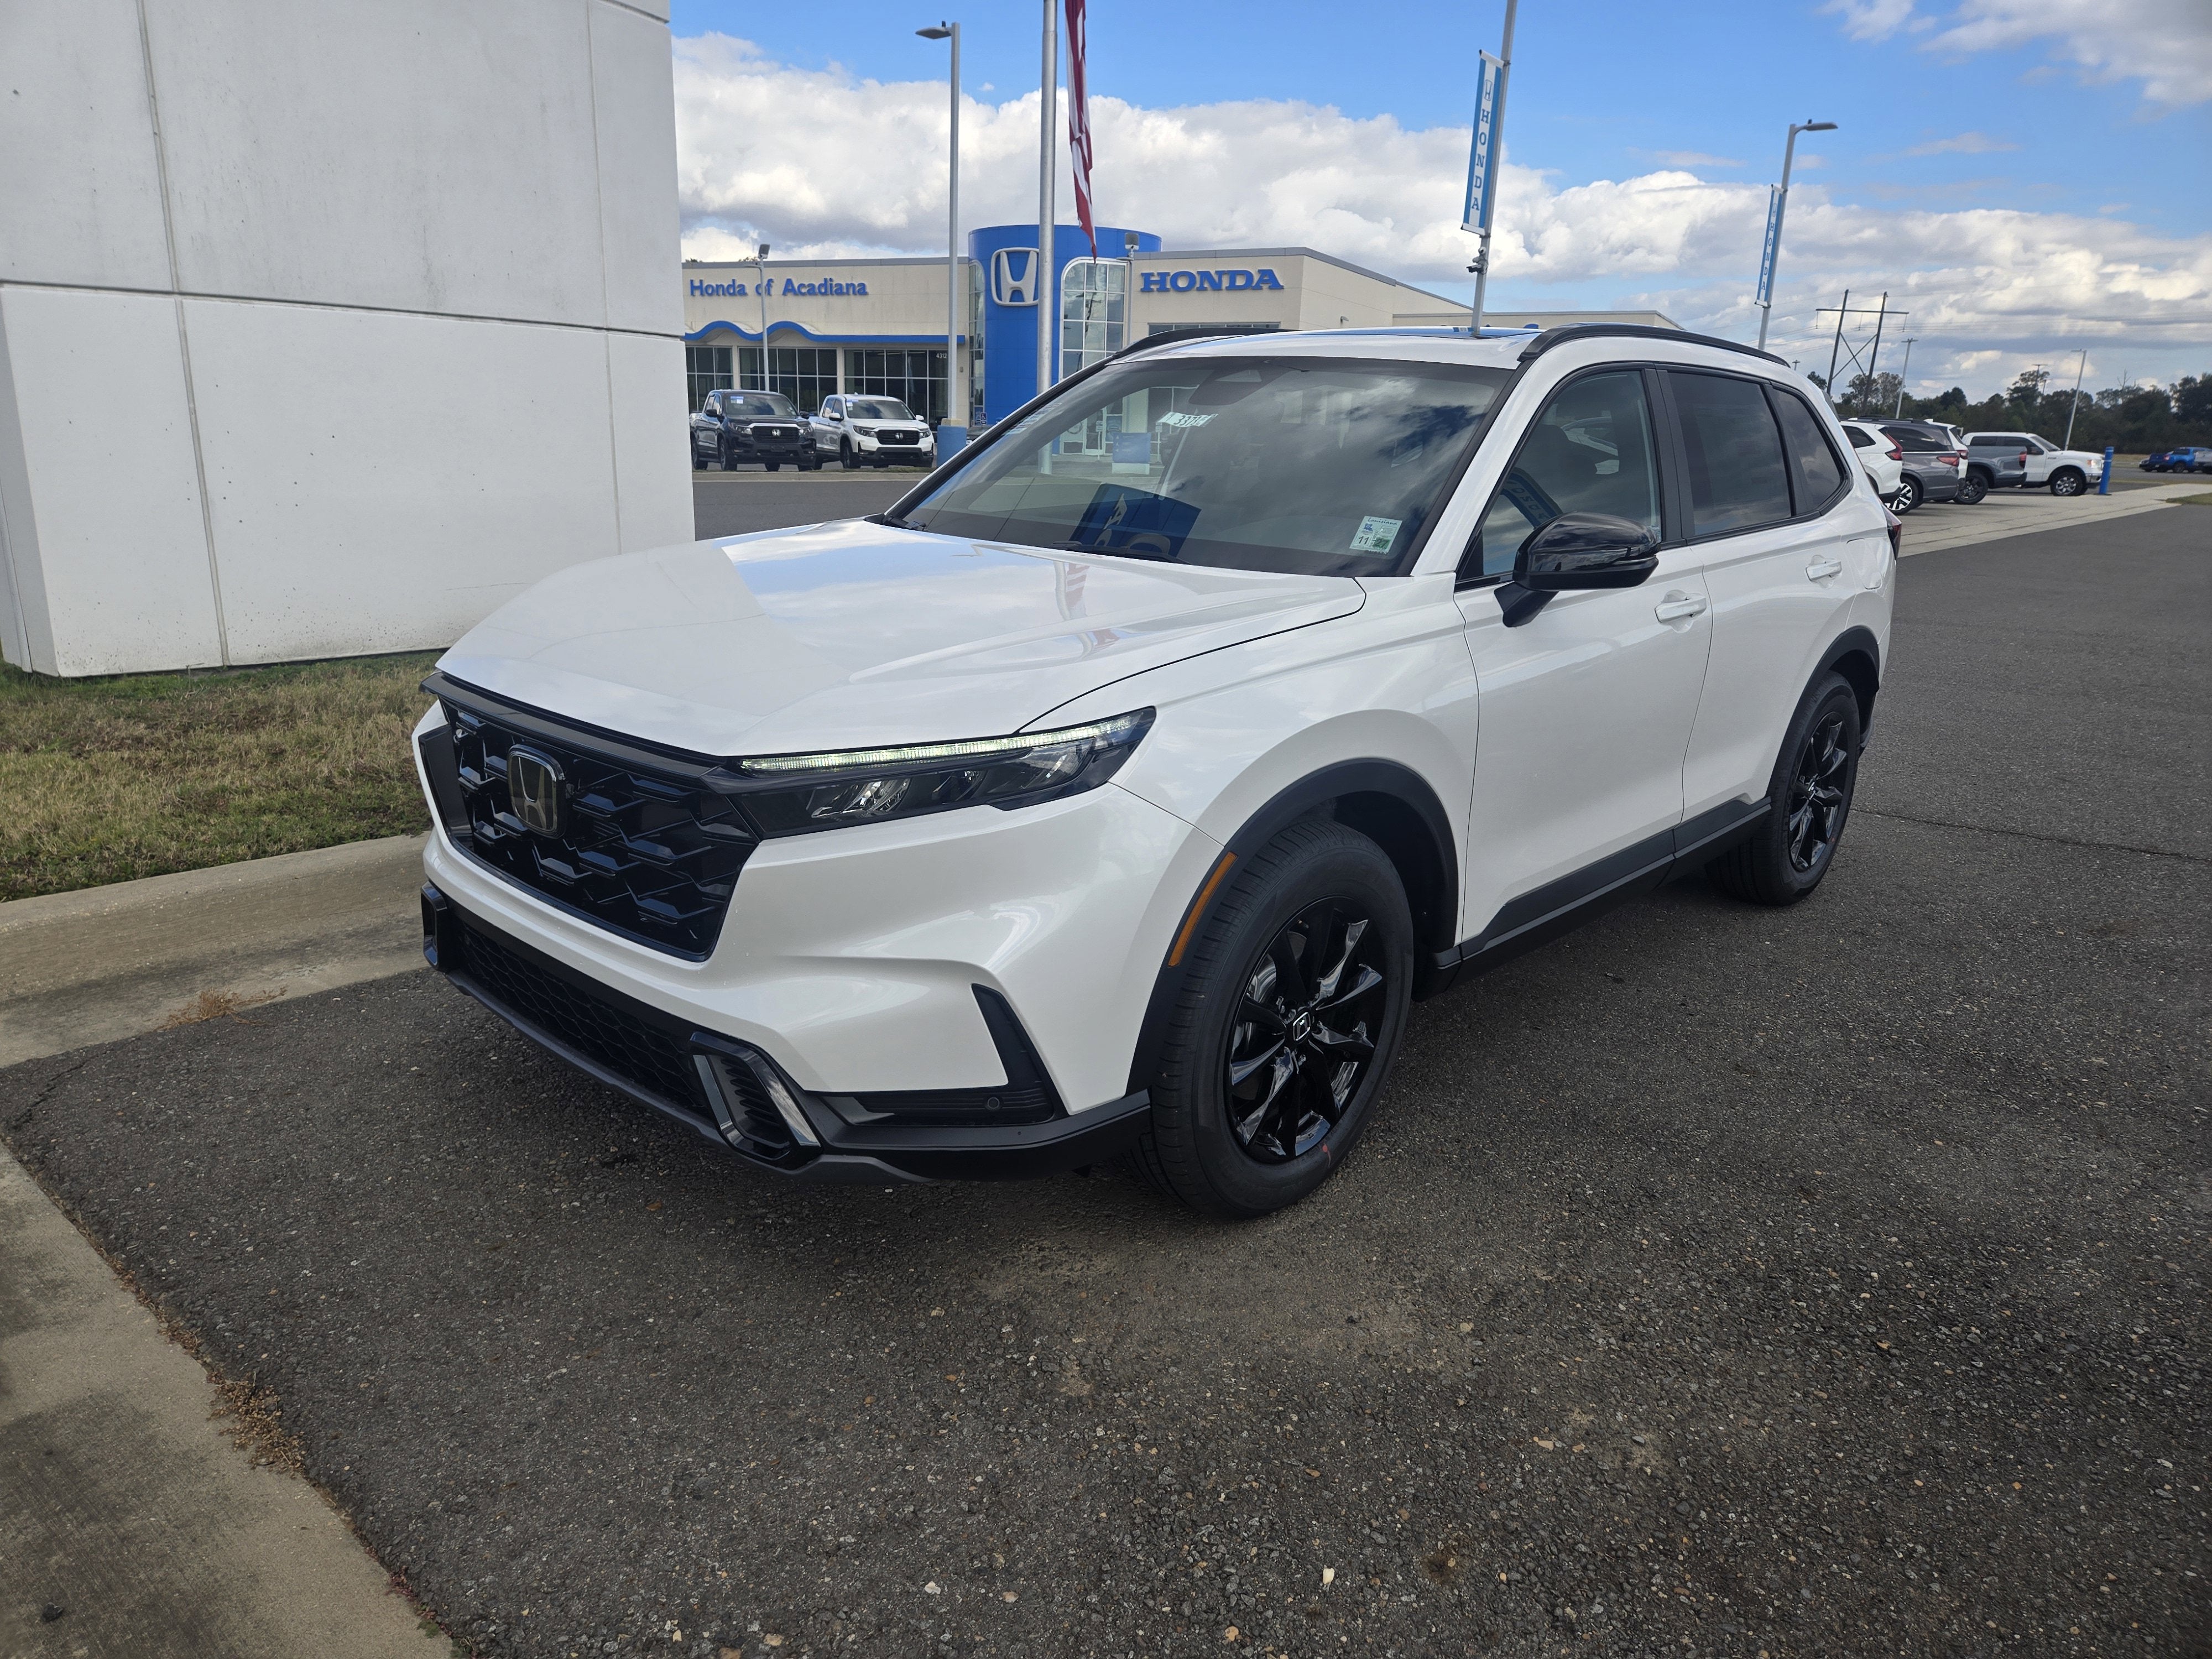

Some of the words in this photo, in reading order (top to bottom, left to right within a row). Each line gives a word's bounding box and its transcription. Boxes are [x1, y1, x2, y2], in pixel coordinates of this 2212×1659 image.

[1471, 108, 1490, 211] HONDA
[1761, 222, 1775, 290] HONDA
[690, 279, 747, 296] Honda
[755, 278, 774, 296] of
[782, 278, 868, 296] Acadiana
[1140, 269, 1284, 293] HONDA
[1368, 517, 1397, 525] Louisiana
[1359, 536, 1370, 545] 11
[1375, 538, 1389, 548] 27
